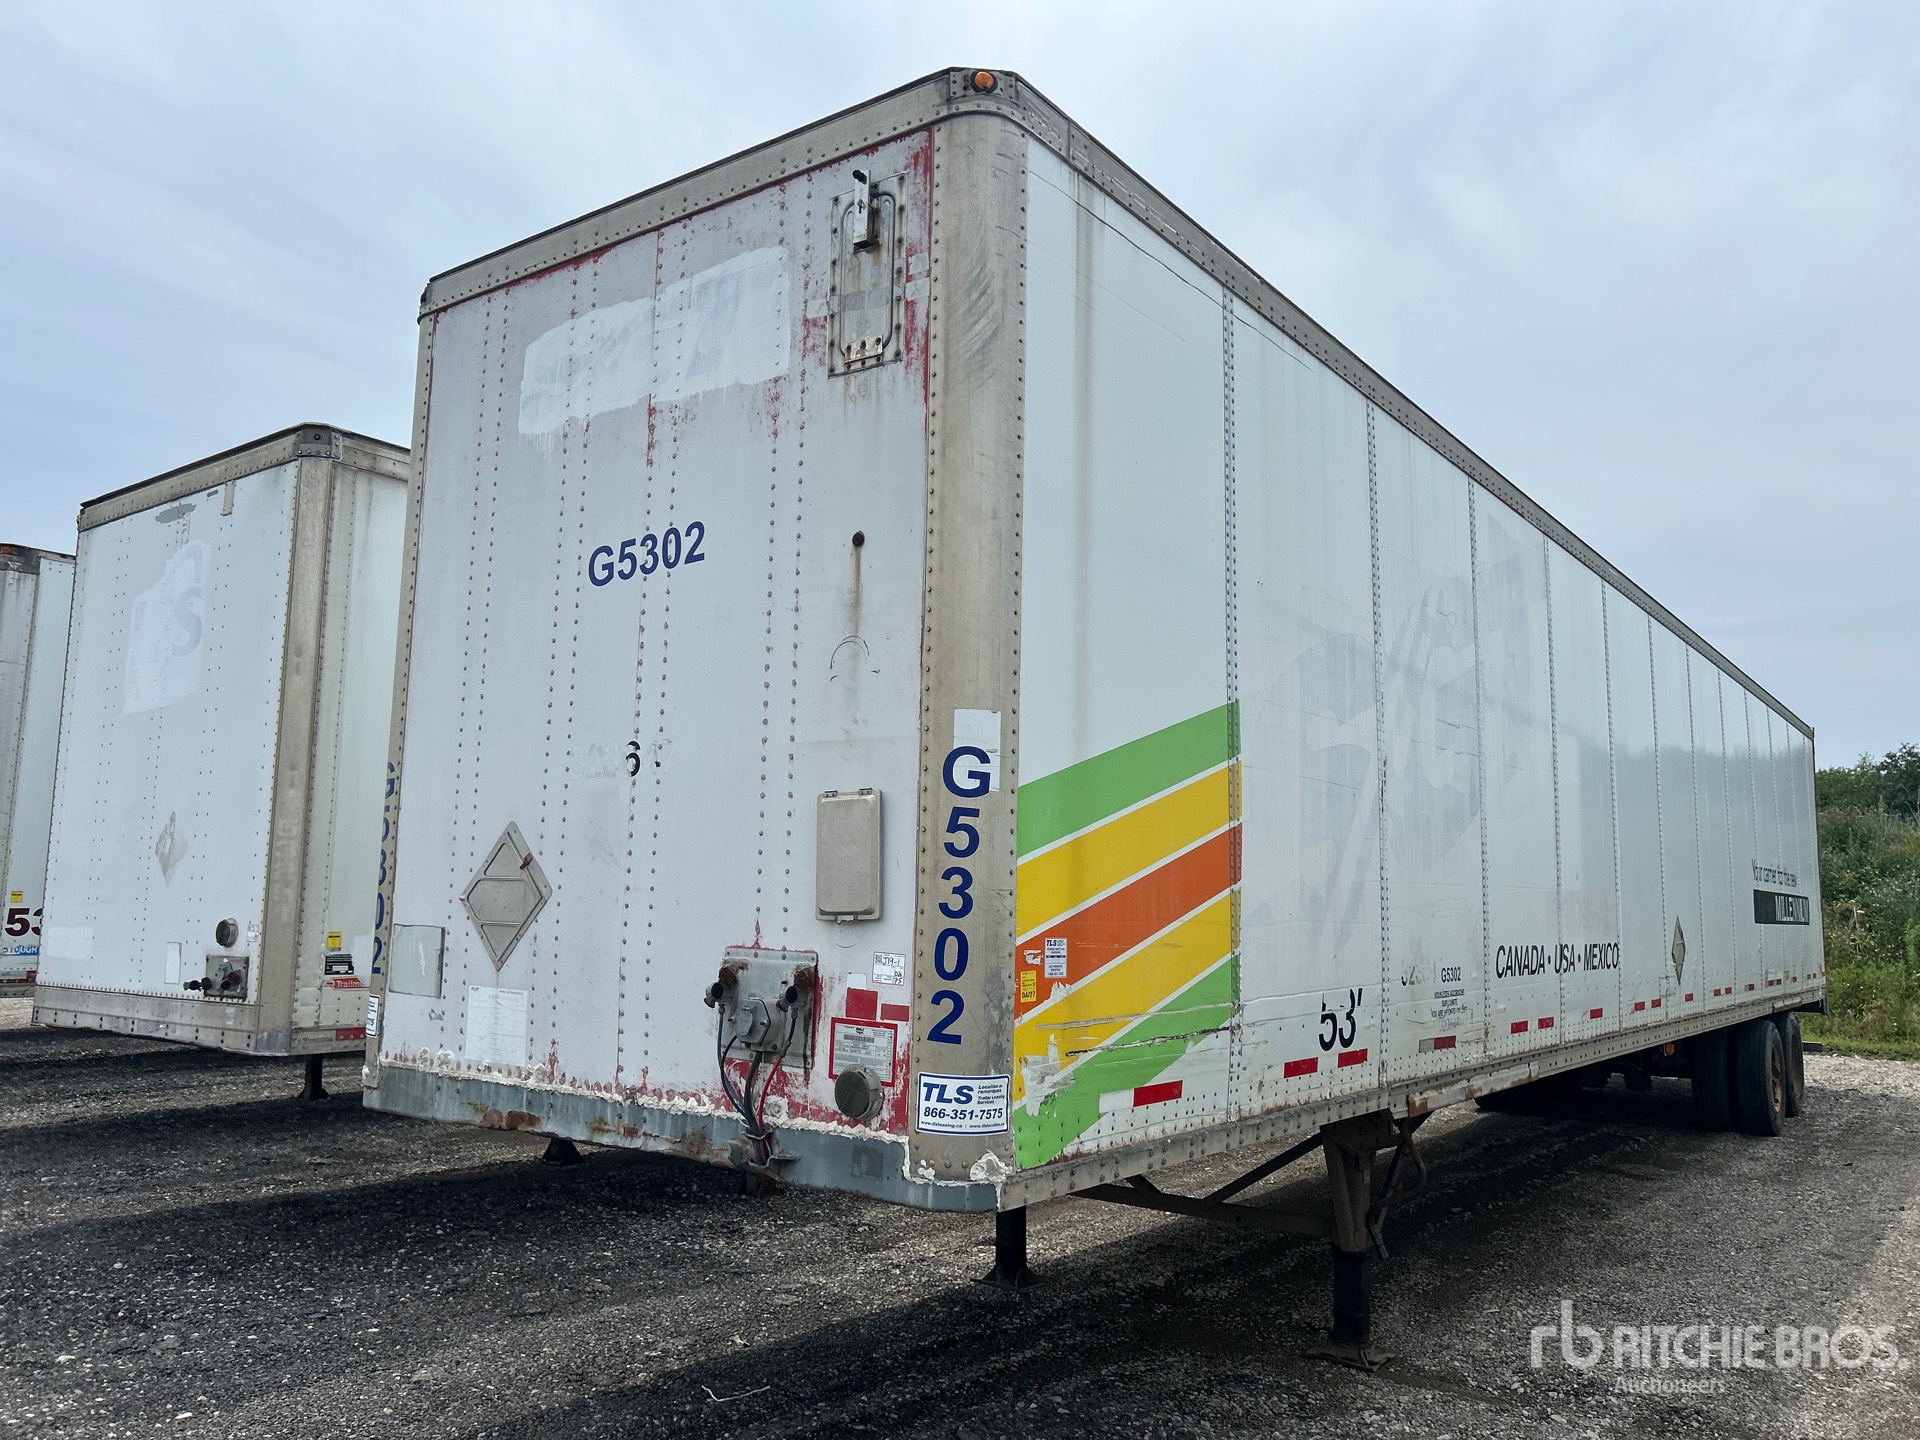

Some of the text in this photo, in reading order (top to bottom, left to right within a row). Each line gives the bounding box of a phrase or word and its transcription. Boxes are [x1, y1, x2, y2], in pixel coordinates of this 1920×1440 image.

[588, 520, 705, 587] G5302
[927, 745, 991, 1045] G5302
[1441, 966, 1462, 983] G5302
[1496, 942, 1620, 979] CANADA USA MEXICO
[923, 1082, 974, 1104] TLS
[923, 1106, 1003, 1121] 866-351-7575
